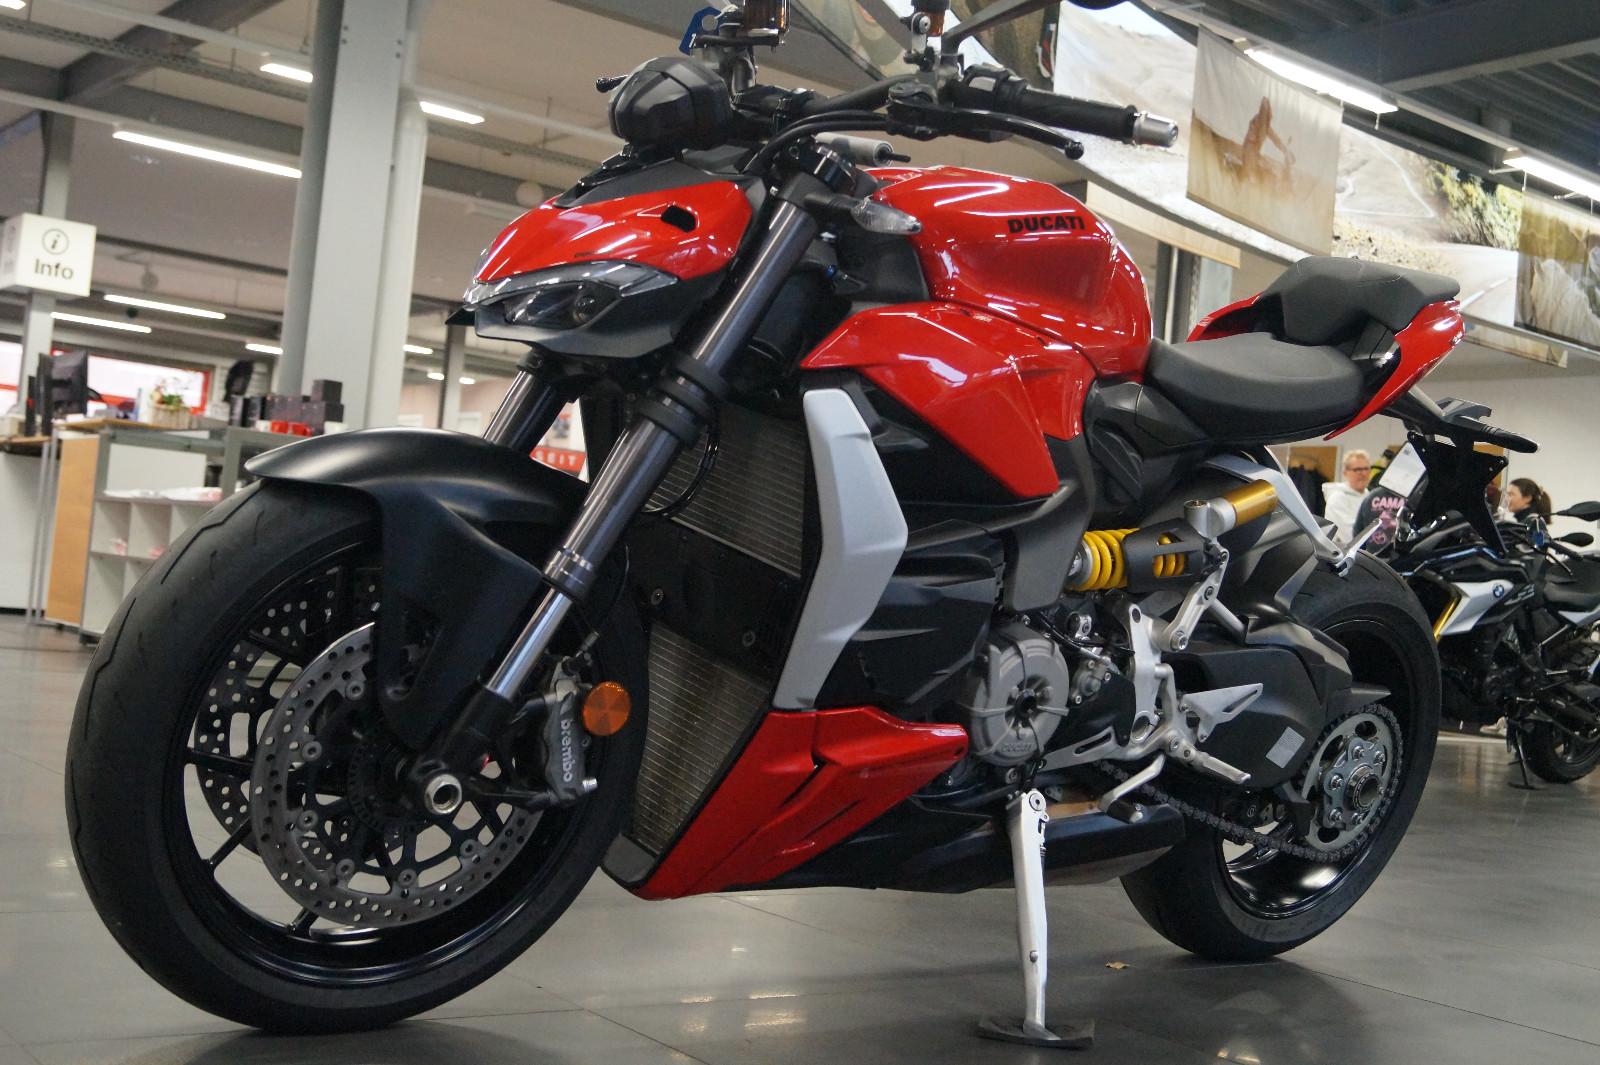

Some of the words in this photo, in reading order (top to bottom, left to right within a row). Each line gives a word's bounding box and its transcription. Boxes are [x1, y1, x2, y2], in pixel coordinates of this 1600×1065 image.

[1008, 215, 1085, 233] DUCATI
[34, 258, 75, 280] Info
[560, 718, 576, 783] brembo
